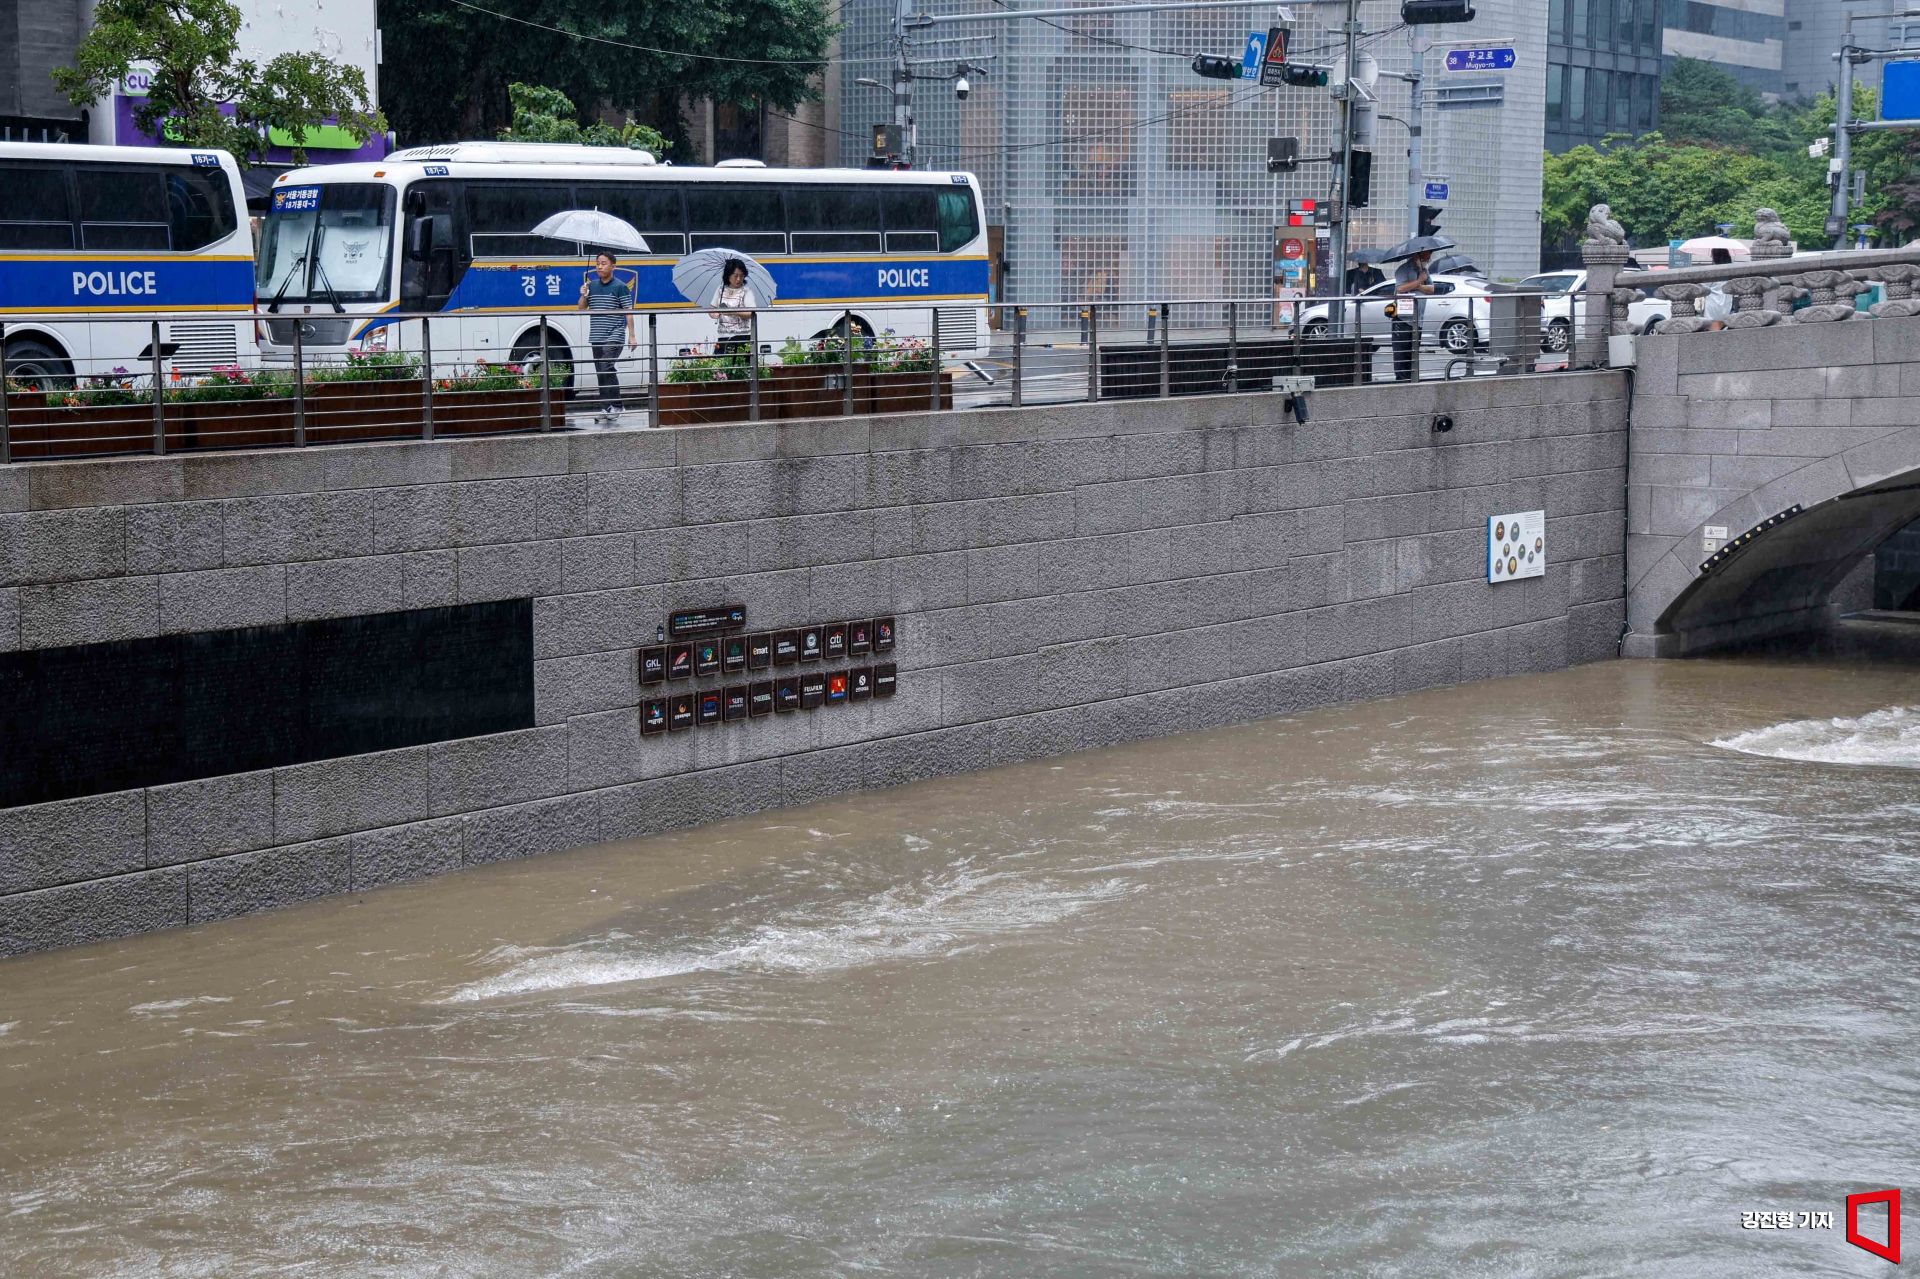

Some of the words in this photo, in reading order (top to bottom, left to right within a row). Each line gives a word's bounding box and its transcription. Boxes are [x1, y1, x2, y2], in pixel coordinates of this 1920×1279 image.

[1468, 51, 1494, 61] 무교로
[1503, 54, 1513, 63] 34
[1448, 57, 1457, 65] 38
[1465, 62, 1496, 70] Mugyo-ro
[877, 268, 929, 288] POLICE
[72, 271, 157, 295] POLICE
[645, 659, 662, 668] GKL
